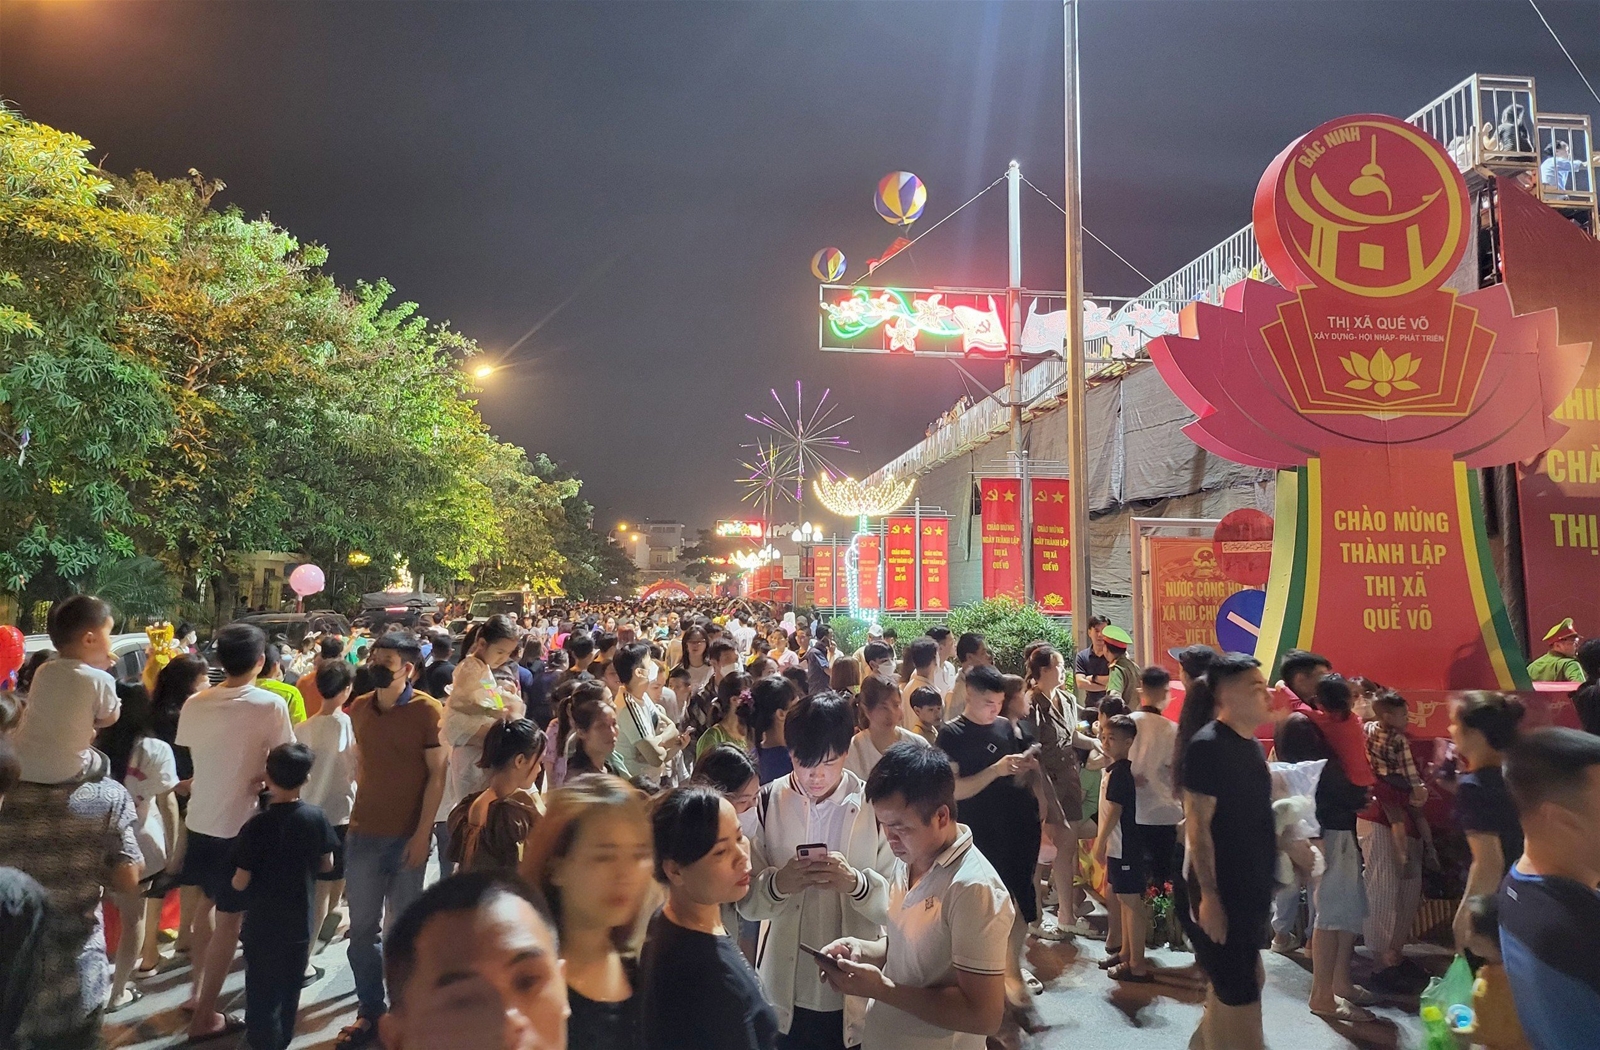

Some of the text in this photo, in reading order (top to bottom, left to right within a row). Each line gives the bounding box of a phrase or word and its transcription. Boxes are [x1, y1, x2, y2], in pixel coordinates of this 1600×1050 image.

[1298, 126, 1361, 169] BẮC NINH
[1327, 316, 1350, 331] THỊ
[1353, 314, 1373, 329] XÃ
[1409, 315, 1430, 331] VÕ
[1334, 504, 1450, 533] CHÀO MỪNG
[1549, 513, 1599, 556] THỊ
[1340, 537, 1447, 570] THÀNH LẬP
[1165, 578, 1194, 598] NƯỚC
[1364, 571, 1428, 602] THỊ XÃ
[1363, 601, 1433, 632] QUẾ VÕ
